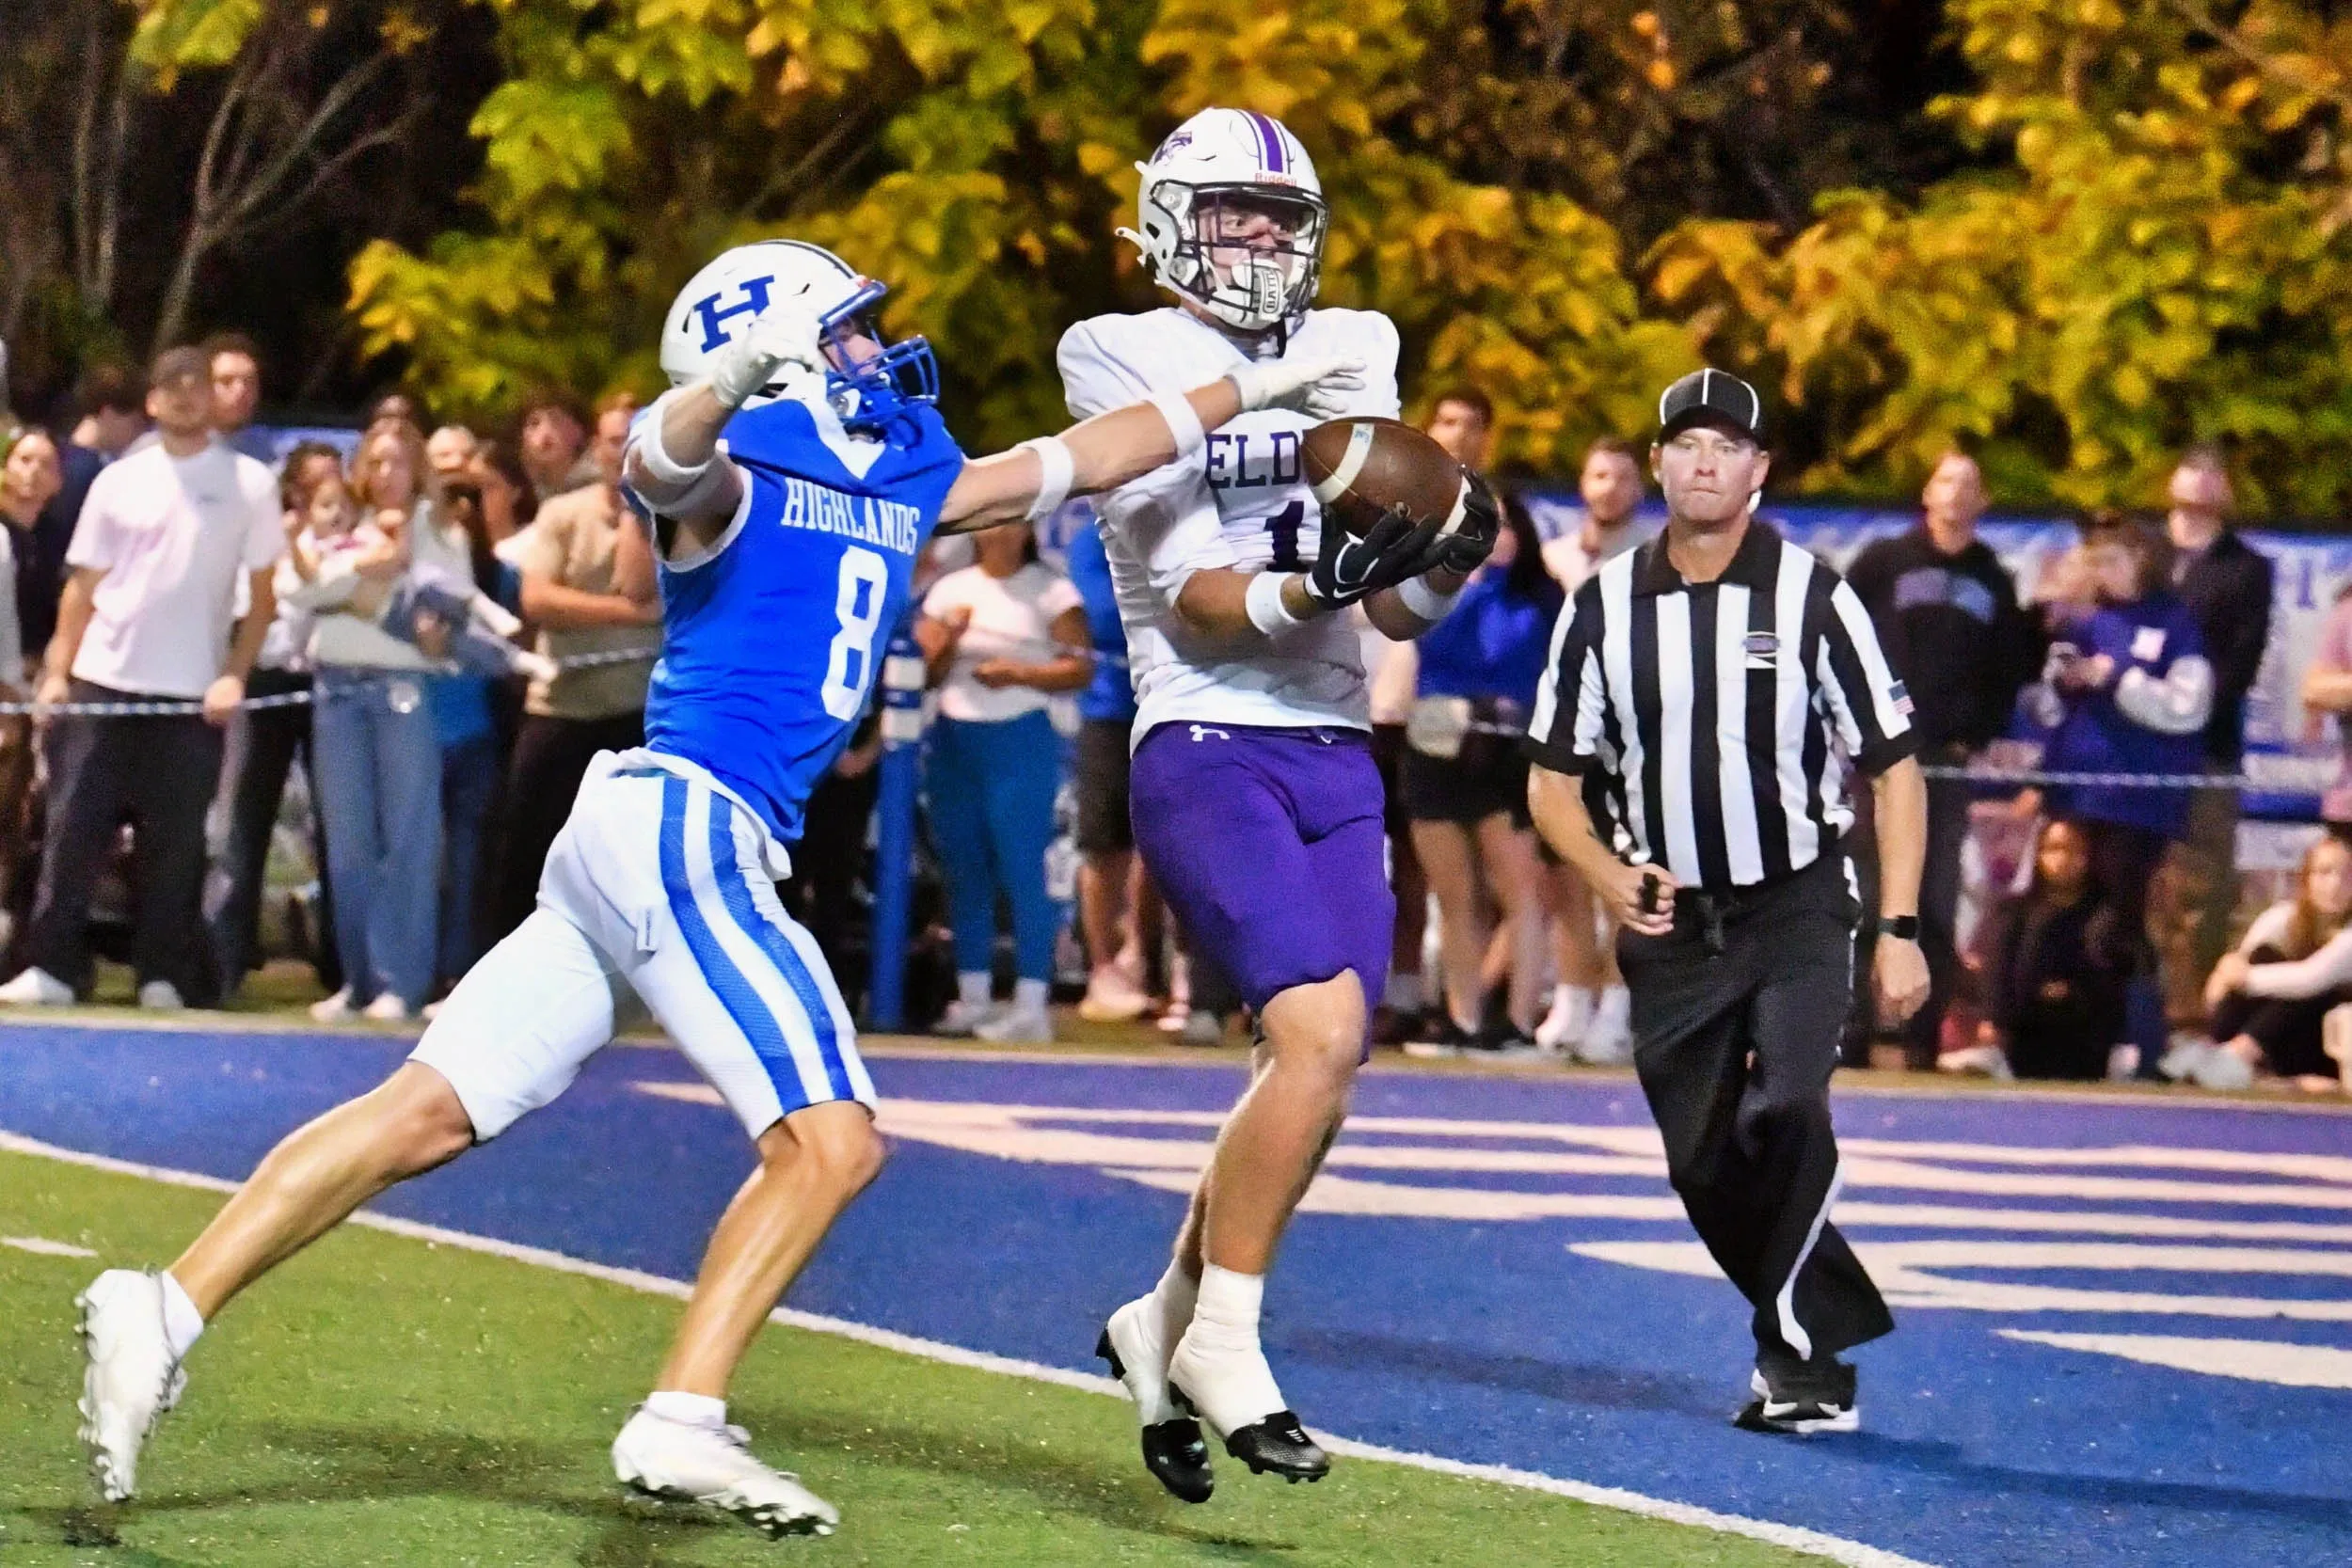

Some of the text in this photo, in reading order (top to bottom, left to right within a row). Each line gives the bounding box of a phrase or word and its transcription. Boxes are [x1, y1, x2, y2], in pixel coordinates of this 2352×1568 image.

[693, 274, 774, 354] H
[1204, 431, 1301, 488] ELD
[780, 476, 920, 556] HIGHLANDS
[1263, 500, 1313, 573] 1
[820, 545, 888, 721] 8
